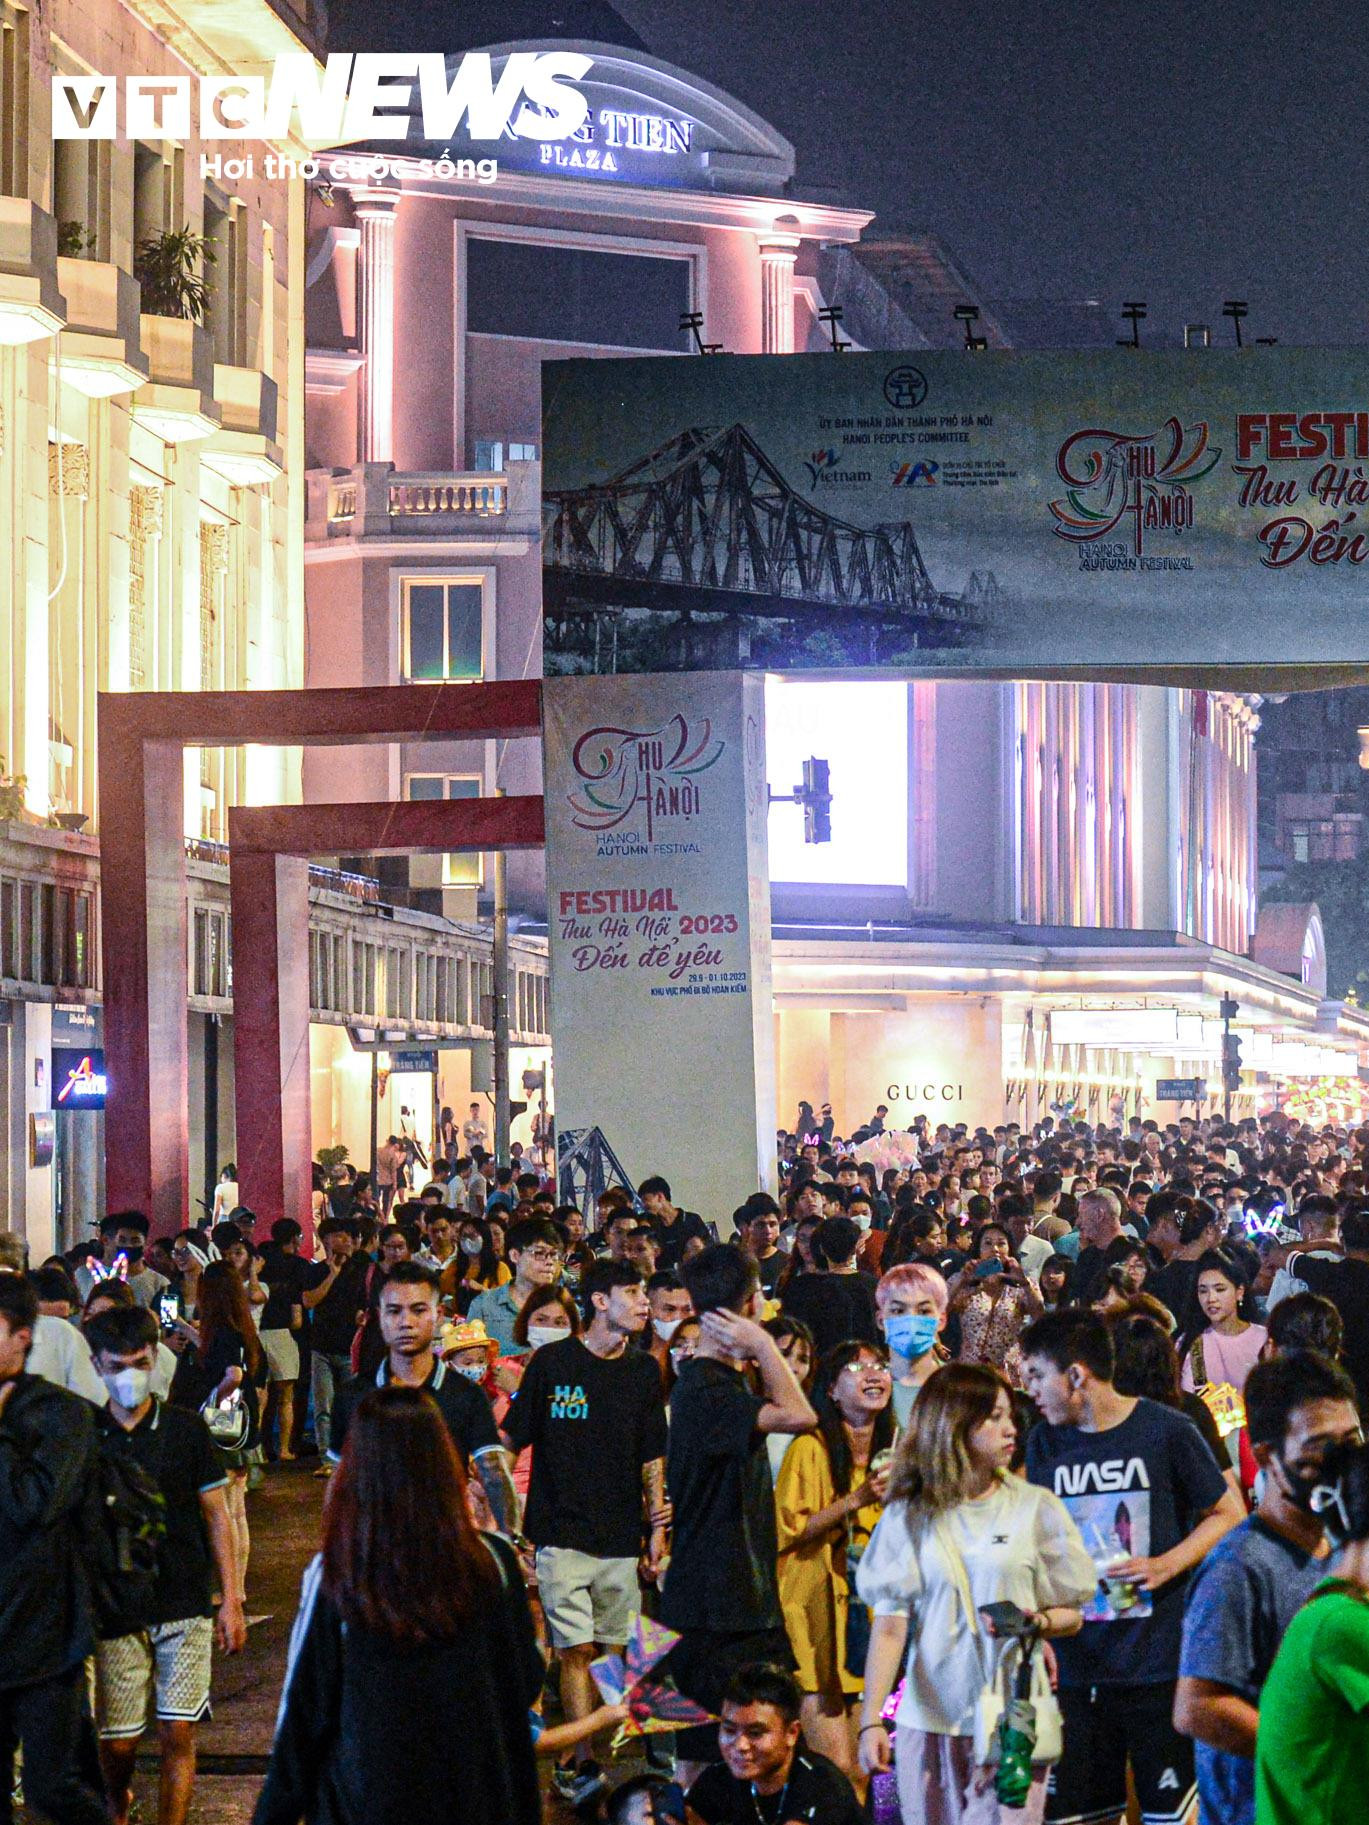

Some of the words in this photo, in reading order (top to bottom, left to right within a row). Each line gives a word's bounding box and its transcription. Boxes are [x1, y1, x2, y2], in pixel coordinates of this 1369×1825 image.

[601, 110, 694, 153] TIEN
[540, 144, 618, 171] PLAZA
[835, 419, 854, 428] BAN
[843, 434, 870, 445] HANOI
[874, 432, 915, 444] PEOPLE'S
[918, 431, 970, 443] COMMITTEE
[1232, 464, 1299, 508] Thu
[1257, 512, 1369, 569] Đến
[1079, 544, 1128, 558] HANOI
[1079, 558, 1136, 570] AUTUMN
[1140, 557, 1194, 570] FESTIVAL
[596, 832, 640, 845] HANOI
[597, 845, 648, 857] AUTUMN
[654, 844, 701, 854] FESTIVAL
[559, 888, 679, 915] FESTIVAL
[559, 918, 592, 940] Thu
[600, 916, 631, 939] Hà
[635, 914, 671, 942] Nội
[679, 914, 738, 935] 2023
[572, 941, 629, 972] Đến
[638, 937, 679, 968] để
[669, 943, 723, 980] yêu
[651, 988, 664, 996] KHU
[887, 1084, 962, 1101] GUCCI
[555, 1385, 585, 1402] HA
[551, 1402, 589, 1419] NOI
[1054, 1457, 1150, 1496] NASA
